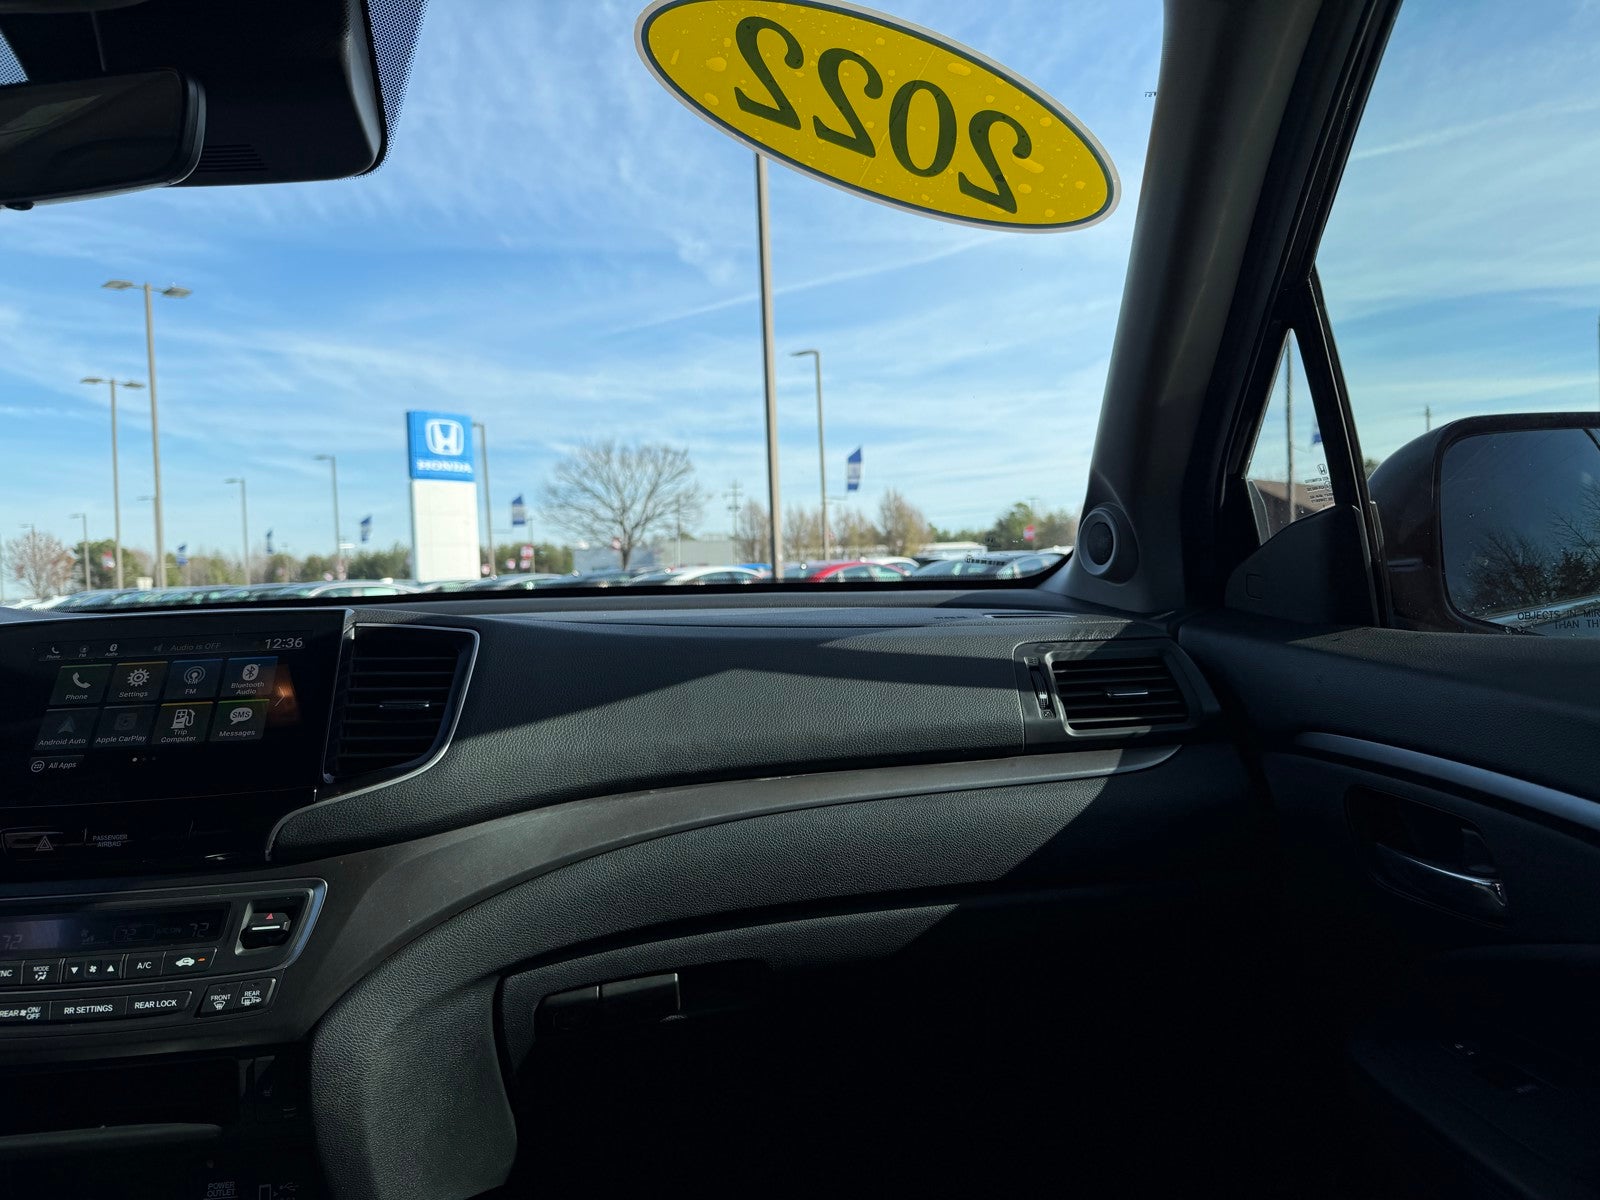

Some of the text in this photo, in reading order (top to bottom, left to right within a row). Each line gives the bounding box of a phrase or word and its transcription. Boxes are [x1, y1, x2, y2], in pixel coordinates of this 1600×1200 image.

[416, 460, 473, 474] HONDA
[1517, 610, 1560, 620] OBJECTS
[1566, 609, 1577, 617] IN
[1554, 620, 1579, 629] THAN
[205, 641, 222, 650] OFF
[265, 637, 303, 649] 12:36
[231, 681, 265, 689] Bluetooth
[119, 691, 148, 699] Settings
[236, 688, 257, 696] Audio
[65, 693, 88, 701] Phone
[232, 711, 251, 719] SMS
[219, 730, 256, 738] Messages
[38, 738, 67, 746] Android
[95, 735, 146, 744] Apple CarPlay
[160, 735, 197, 744] Computer
[48, 761, 77, 770] All Apps
[96, 840, 121, 848] AIRBAG
[190, 922, 209, 937] 72
[136, 961, 152, 970] A/C
[134, 999, 178, 1009] REAR LOCK
[0, 1009, 19, 1017] REAR
[64, 1004, 114, 1015] RR SETTINGS
[207, 1181, 235, 1190] POWER
[206, 1188, 236, 1198] OUTLET
